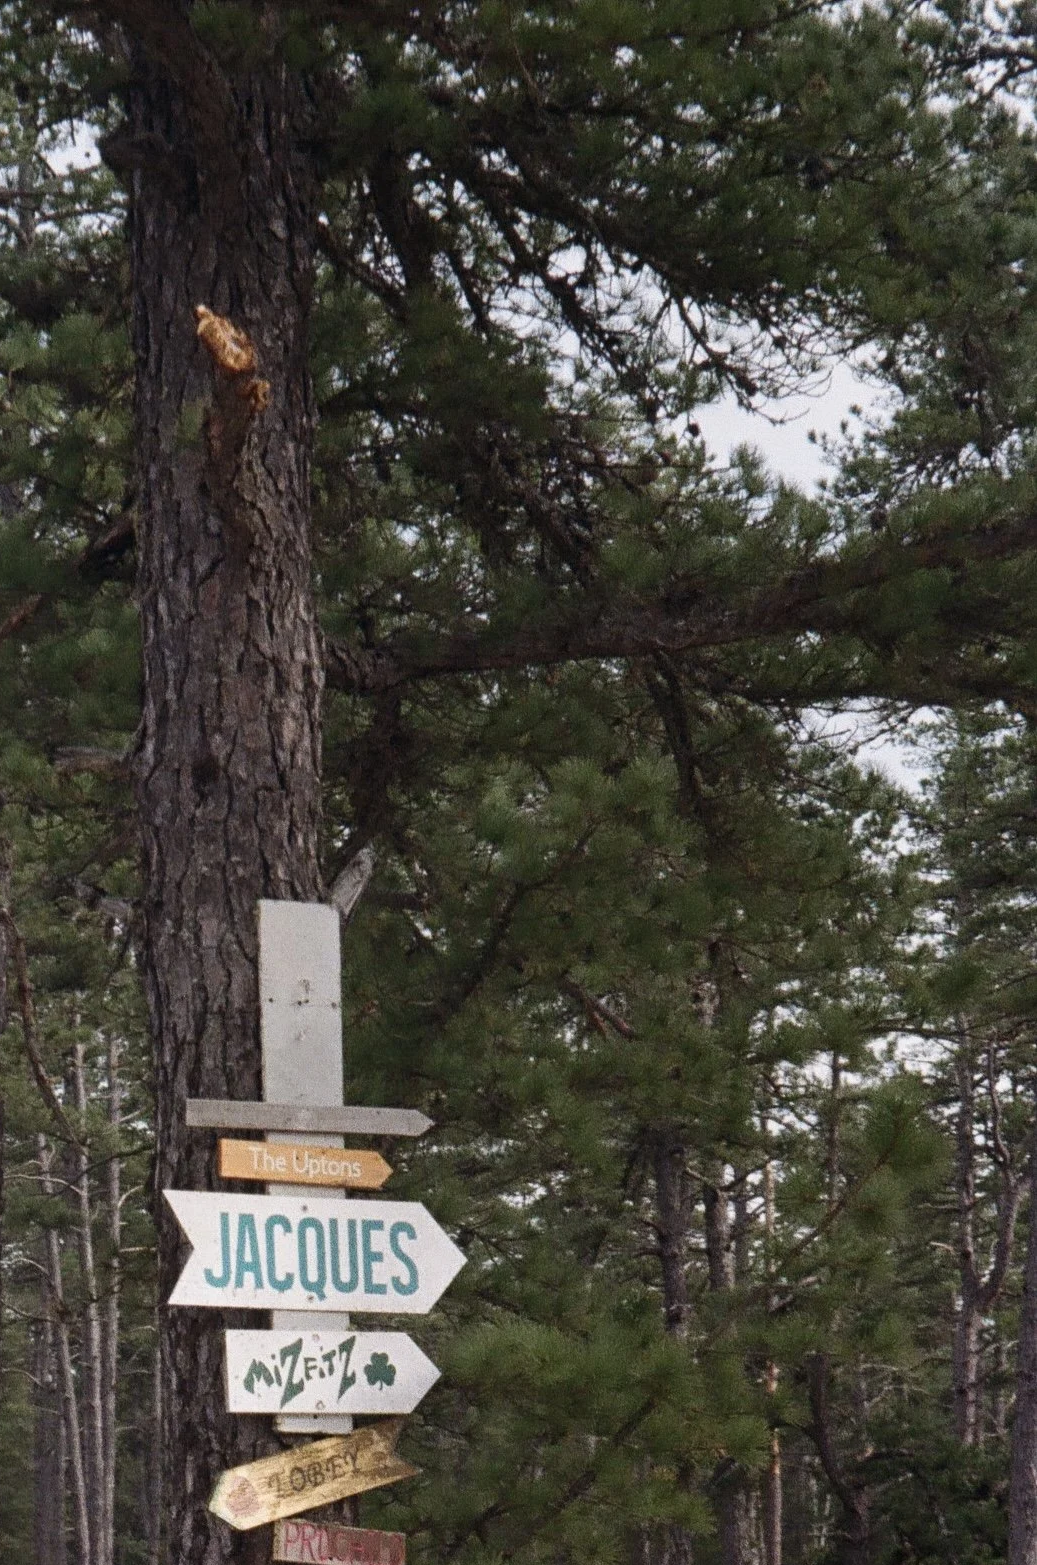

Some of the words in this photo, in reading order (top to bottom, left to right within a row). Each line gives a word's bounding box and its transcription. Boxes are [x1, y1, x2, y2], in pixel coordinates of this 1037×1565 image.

[251, 1147, 286, 1172] The
[292, 1151, 362, 1178] Uptons
[204, 1212, 420, 1301] JACQUES
